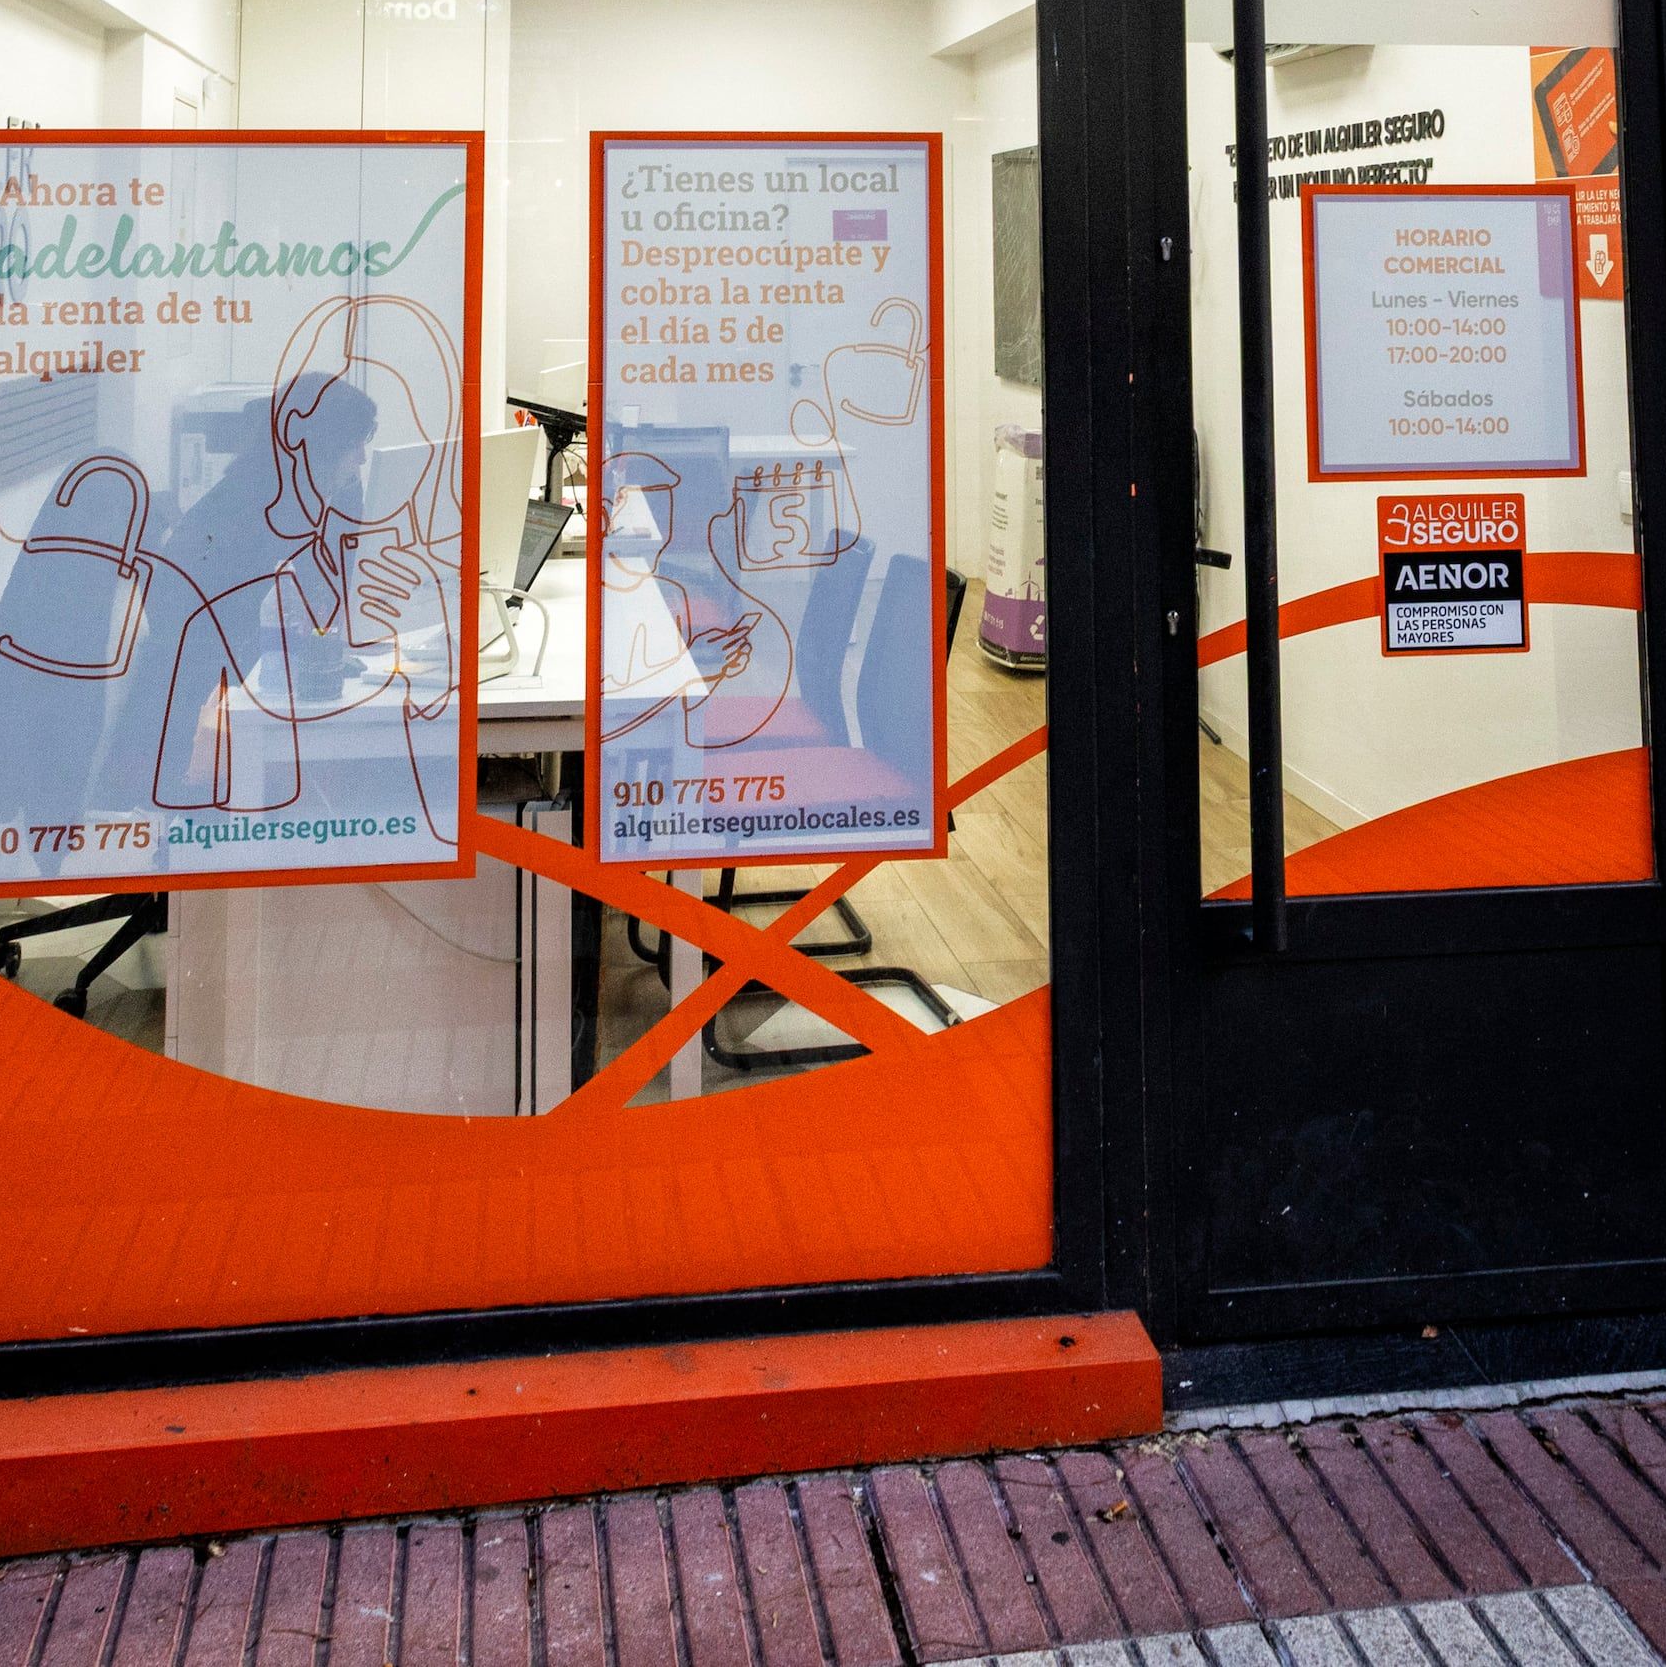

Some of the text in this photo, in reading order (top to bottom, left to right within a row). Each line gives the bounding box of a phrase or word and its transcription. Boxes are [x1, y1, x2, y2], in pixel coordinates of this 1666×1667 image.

[1288, 134, 1303, 159] DE
[1304, 129, 1321, 156] UN
[1323, 119, 1382, 154] ALQUILER
[1384, 108, 1445, 145] SEGURO
[130, 176, 165, 207] te
[621, 164, 899, 200] ¿Tienes un local
[621, 203, 790, 232] u oficina?
[1395, 229, 1492, 248] HORARIO
[621, 239, 891, 274] Despreocúpate y
[1383, 257, 1506, 275] COMERCIAL
[621, 278, 845, 306] cobra la renta
[1371, 290, 1428, 309] Lunes
[1447, 290, 1519, 309] Viernes
[41, 296, 146, 326] renta
[156, 291, 203, 325] de
[214, 295, 253, 325] tu
[621, 316, 784, 345] el día 5 de
[1386, 318, 1506, 336] 10:00-14:00
[621, 355, 775, 383] cada mes
[1387, 346, 1507, 364] 17:00-20:00
[1403, 389, 1494, 408] Sábados
[1388, 417, 1509, 436] 10:00-14:00
[1413, 502, 1517, 521] ALQUILER
[1412, 520, 1519, 545] SEGURO
[1395, 562, 1509, 591] AENOR
[1396, 604, 1504, 619] COMPROMISO CON
[1397, 618, 1487, 631] LAS PERSONAS
[1397, 632, 1454, 644] MAYORES
[614, 775, 786, 807] 910 775 775
[29, 823, 85, 854] 775
[94, 821, 151, 851] 775
[167, 815, 418, 849] alquilerseguro.es
[614, 806, 921, 841] alquilersegurolocales.es
